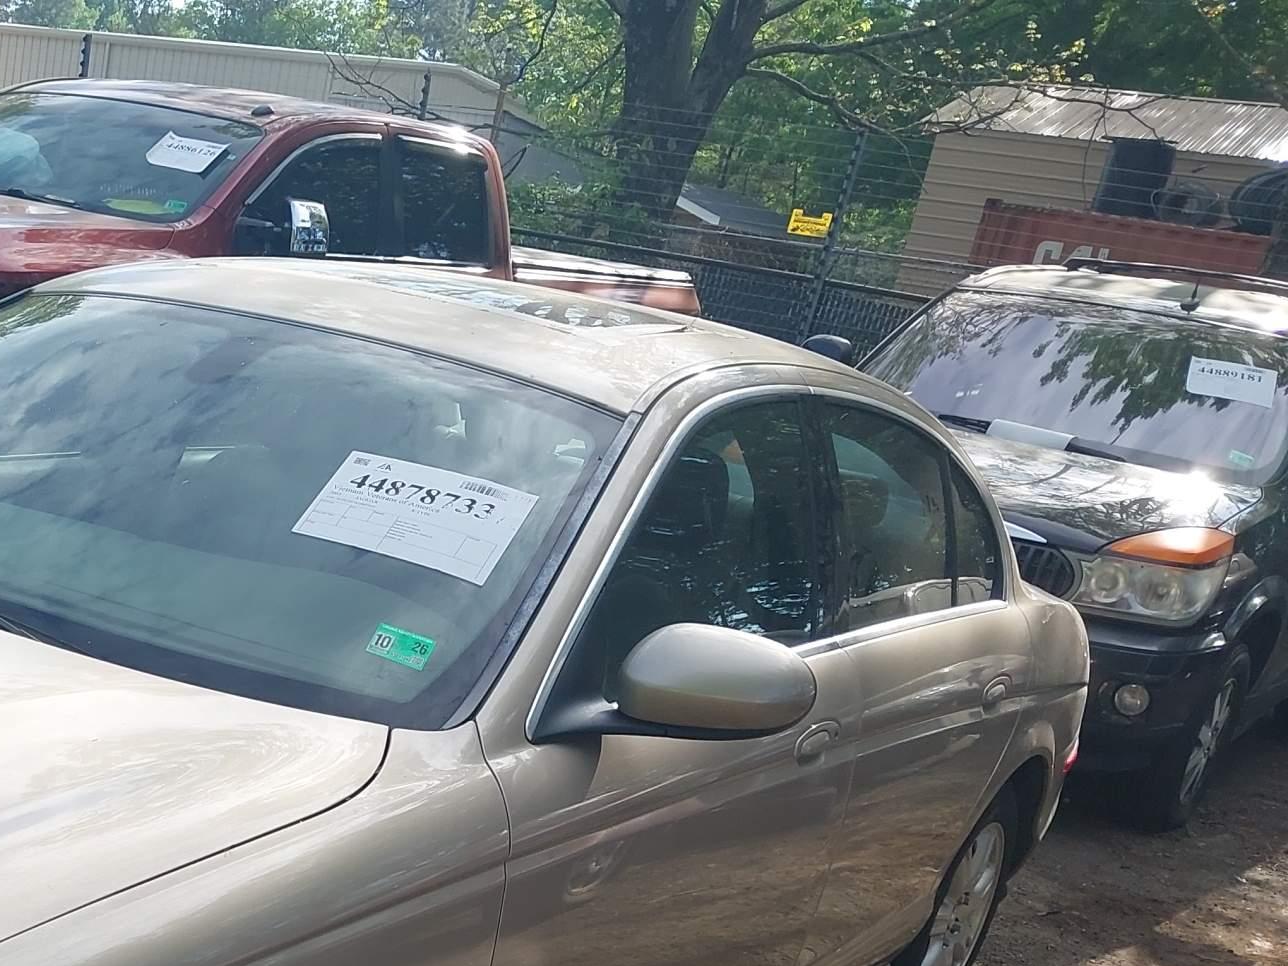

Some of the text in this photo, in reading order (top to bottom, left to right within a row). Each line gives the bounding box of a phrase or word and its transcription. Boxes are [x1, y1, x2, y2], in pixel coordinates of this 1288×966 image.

[1198, 366, 1262, 382] 44889181
[350, 474, 496, 520] 44878733
[374, 633, 429, 655] 10 26
